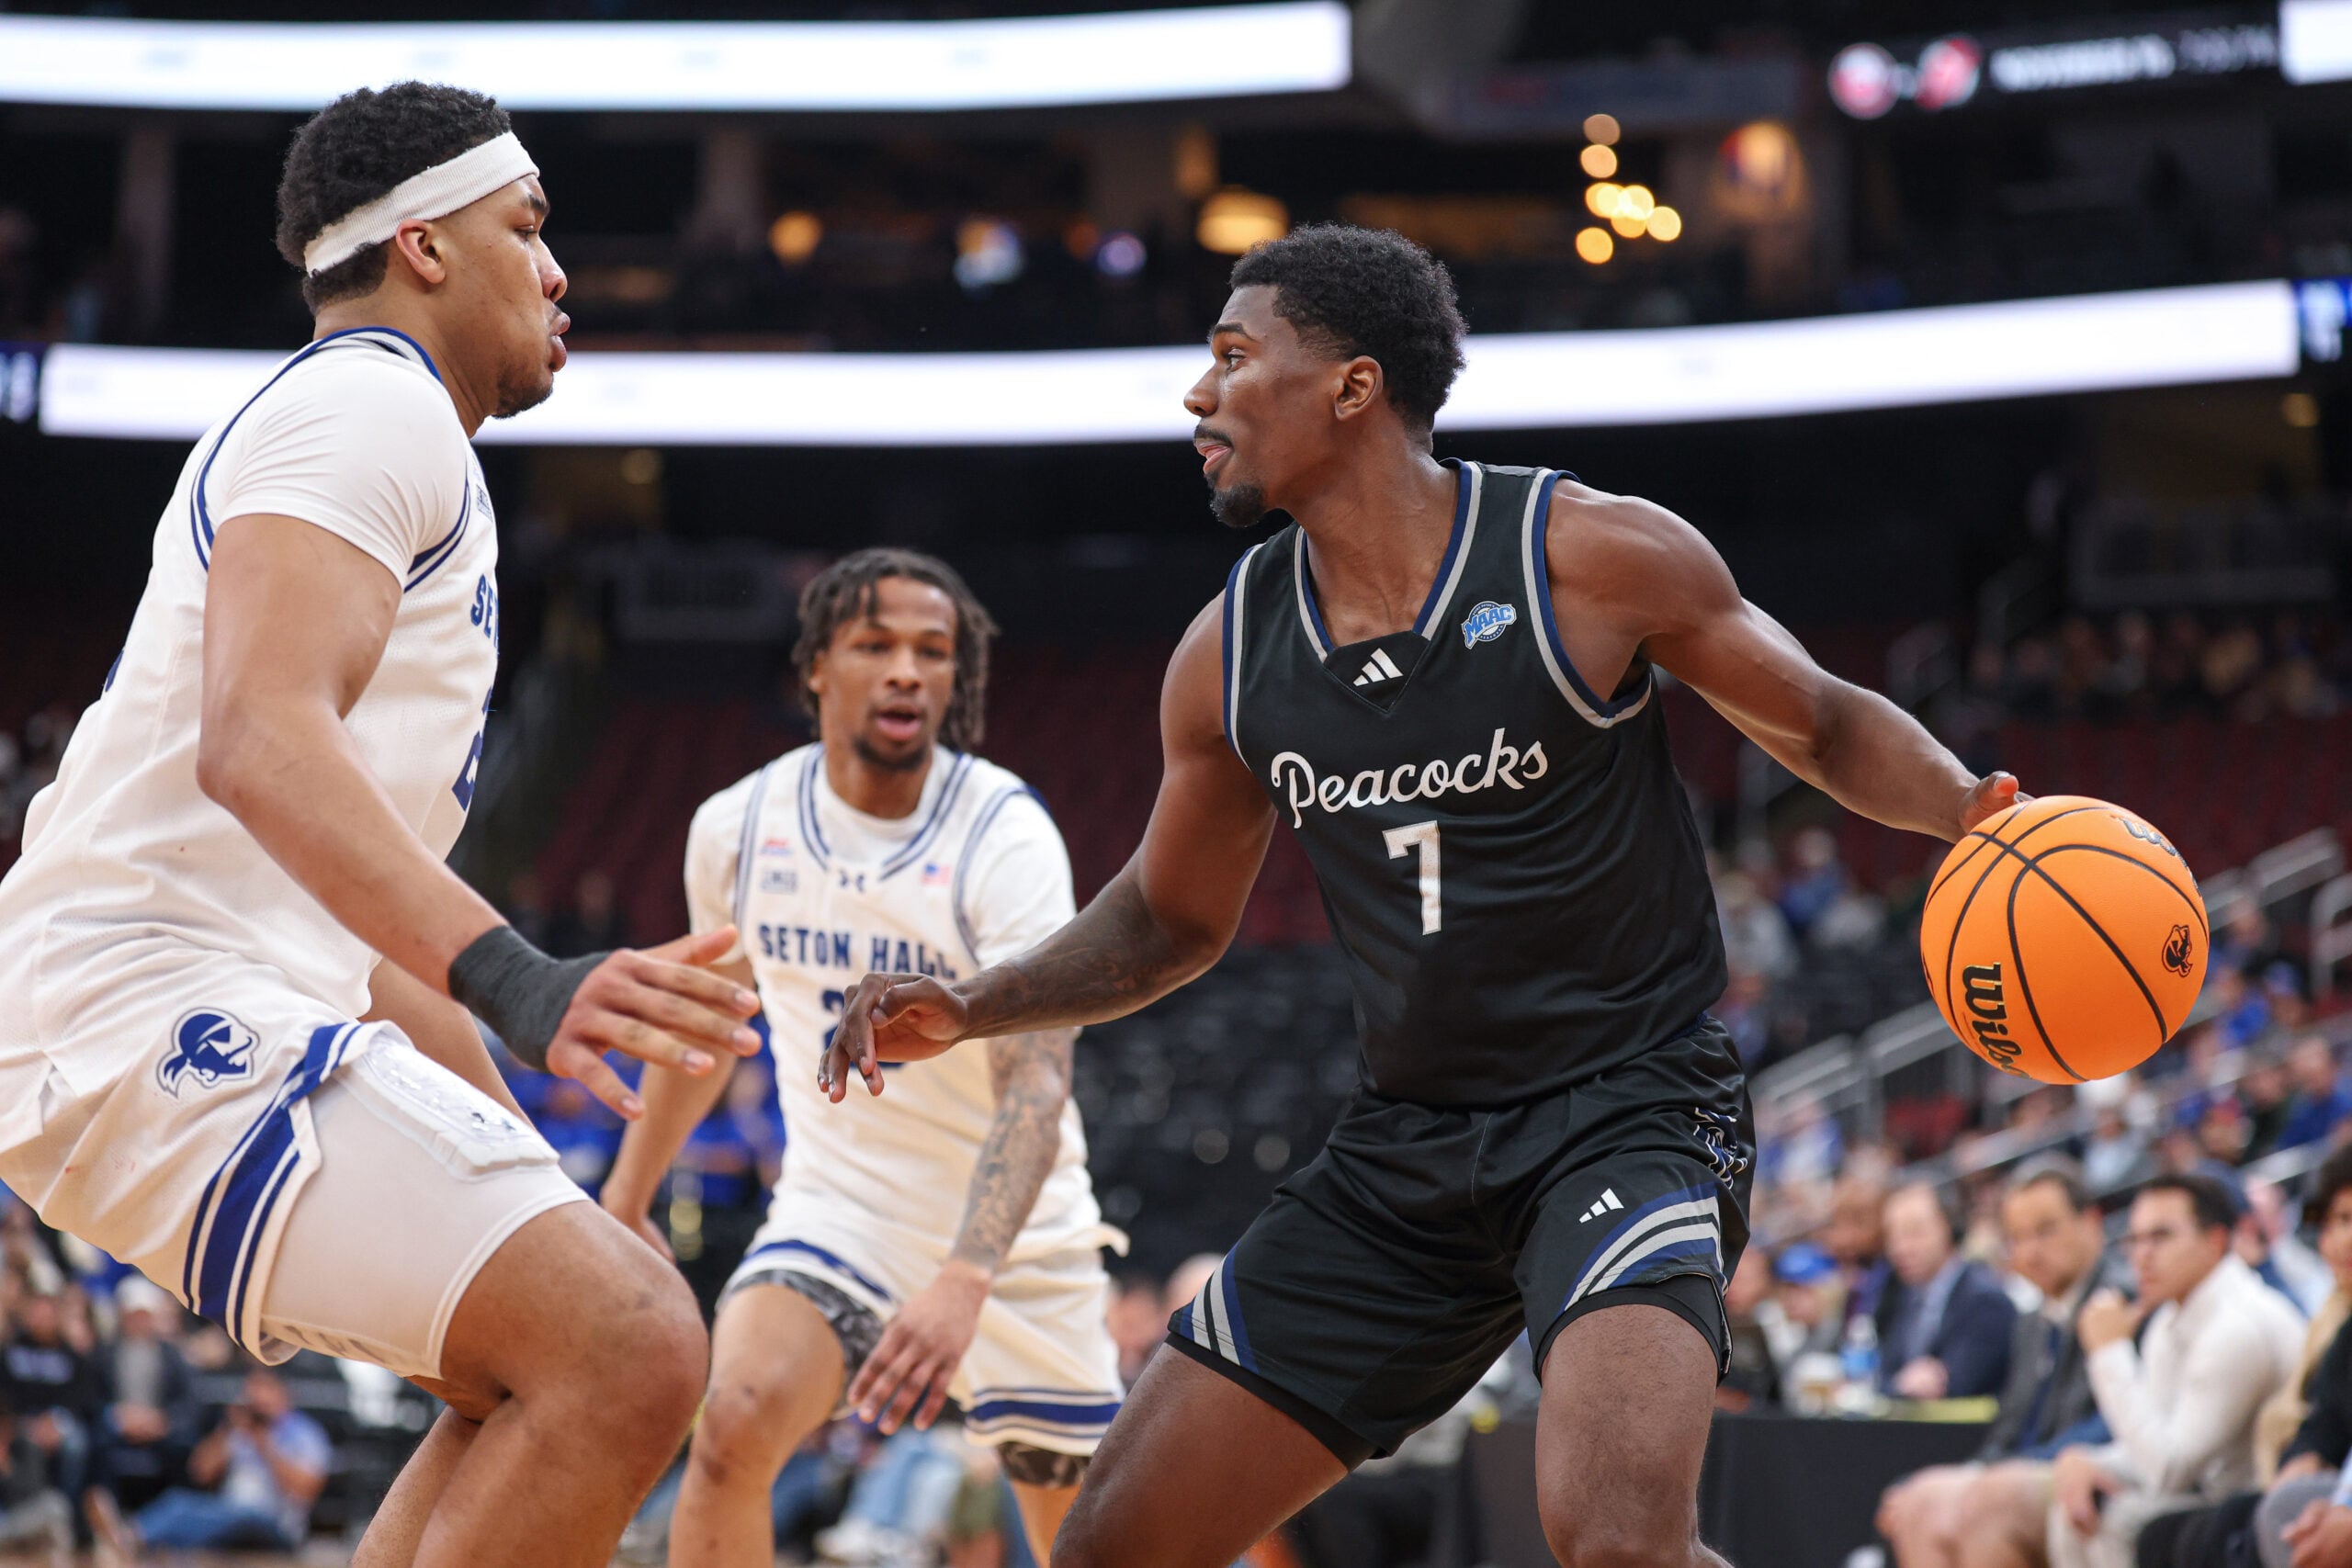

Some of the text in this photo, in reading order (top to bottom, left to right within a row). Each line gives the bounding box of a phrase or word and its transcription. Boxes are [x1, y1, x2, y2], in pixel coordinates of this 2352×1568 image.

[1462, 604, 1514, 646] MAAC
[1271, 727, 1548, 829] Peacocks
[1381, 819, 1442, 935] 7
[759, 924, 956, 980] SETON HALL
